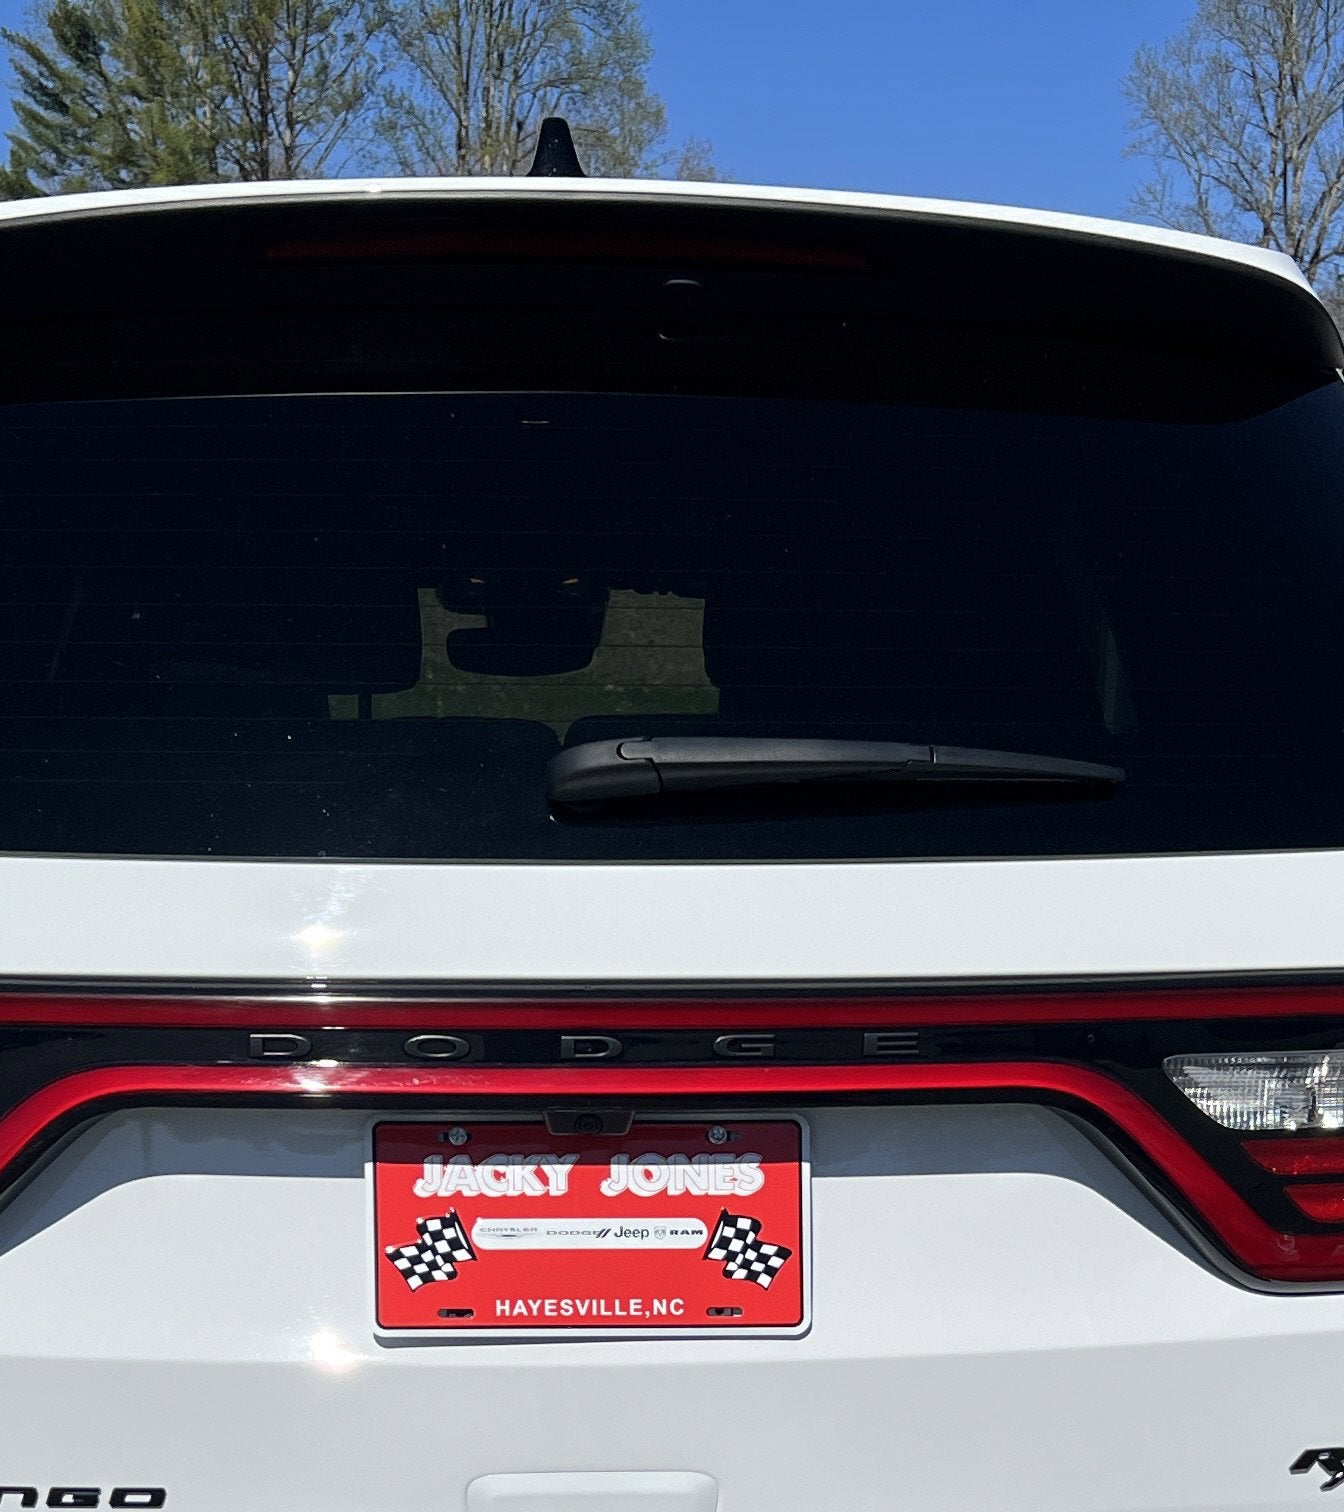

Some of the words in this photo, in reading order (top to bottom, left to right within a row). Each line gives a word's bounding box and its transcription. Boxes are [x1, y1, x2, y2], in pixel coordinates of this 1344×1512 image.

[249, 1031, 920, 1059] DODGE
[413, 1153, 580, 1198] JACKY
[599, 1152, 765, 1198] JONES
[613, 1225, 650, 1241] Jeep
